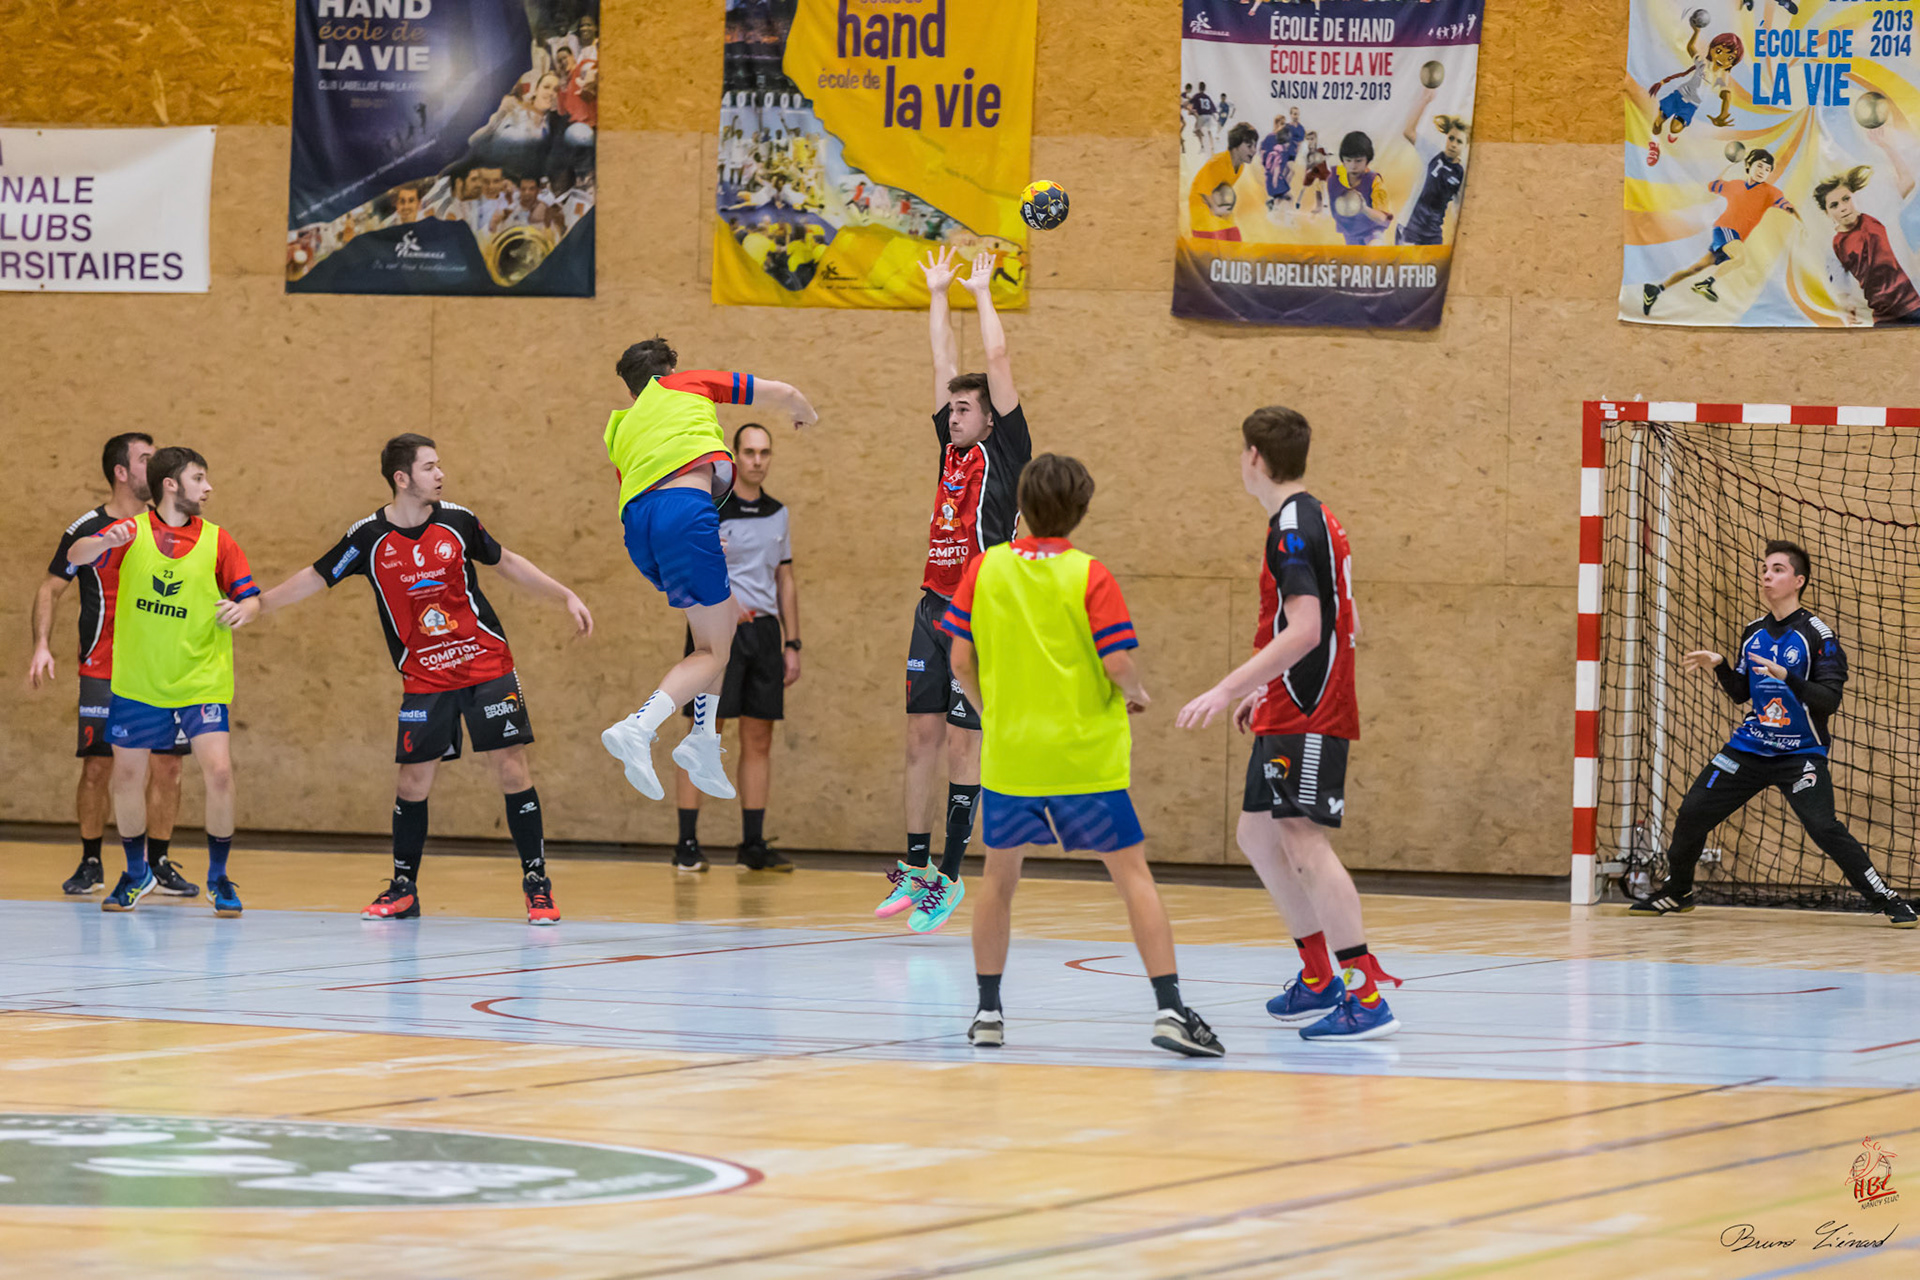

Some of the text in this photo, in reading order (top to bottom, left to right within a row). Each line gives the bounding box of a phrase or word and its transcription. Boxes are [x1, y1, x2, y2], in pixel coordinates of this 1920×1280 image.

[318, 0, 431, 19] HAND
[1872, 9, 1913, 32] 2013
[319, 20, 428, 41] école de
[837, 0, 945, 59] hand
[1270, 11, 1395, 42] ÉCOLE DE HAND
[1754, 20, 1853, 58] ÉCOLE DE
[1870, 34, 1911, 57] 2014
[317, 44, 431, 71] LA VIE
[1270, 45, 1393, 76] ÉCOLE DE LA VIE
[818, 67, 881, 90] école de
[1271, 80, 1392, 100] SAISON 2012-2013
[1752, 63, 1851, 106] LA VIE
[884, 65, 1001, 130] la vie
[1210, 258, 1437, 288] CLUB LABELLISÉ PAR LA FFHB
[412, 543, 426, 568] 6
[163, 569, 174, 579] 23
[400, 573, 416, 583] Guy
[136, 598, 187, 619] erima
[403, 731, 413, 752] 6
